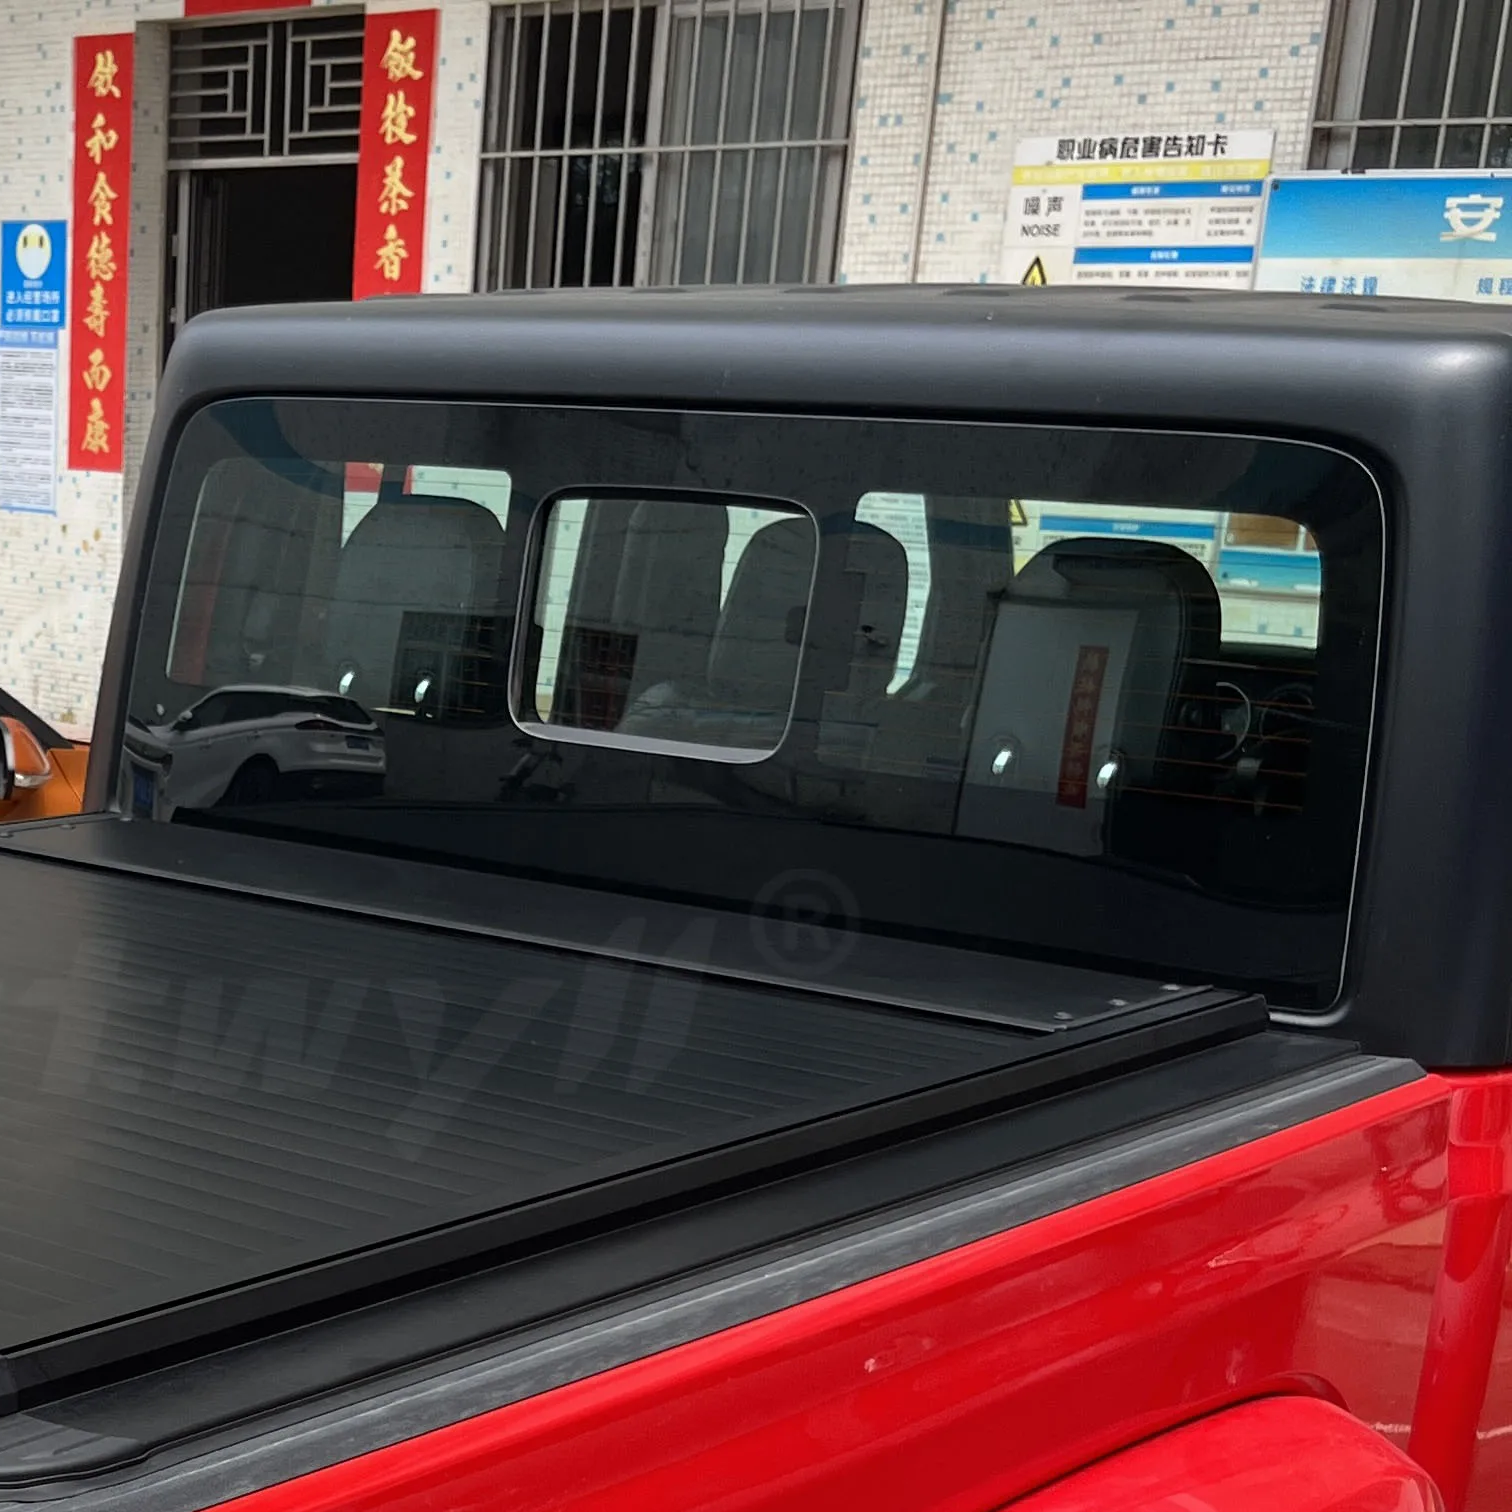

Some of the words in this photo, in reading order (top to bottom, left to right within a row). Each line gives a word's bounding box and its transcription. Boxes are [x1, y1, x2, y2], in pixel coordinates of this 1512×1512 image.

[1056, 134, 1228, 160] 职业病危害告知卡
[1020, 224, 1060, 237] NOISE
[1440, 193, 1504, 242] 安
